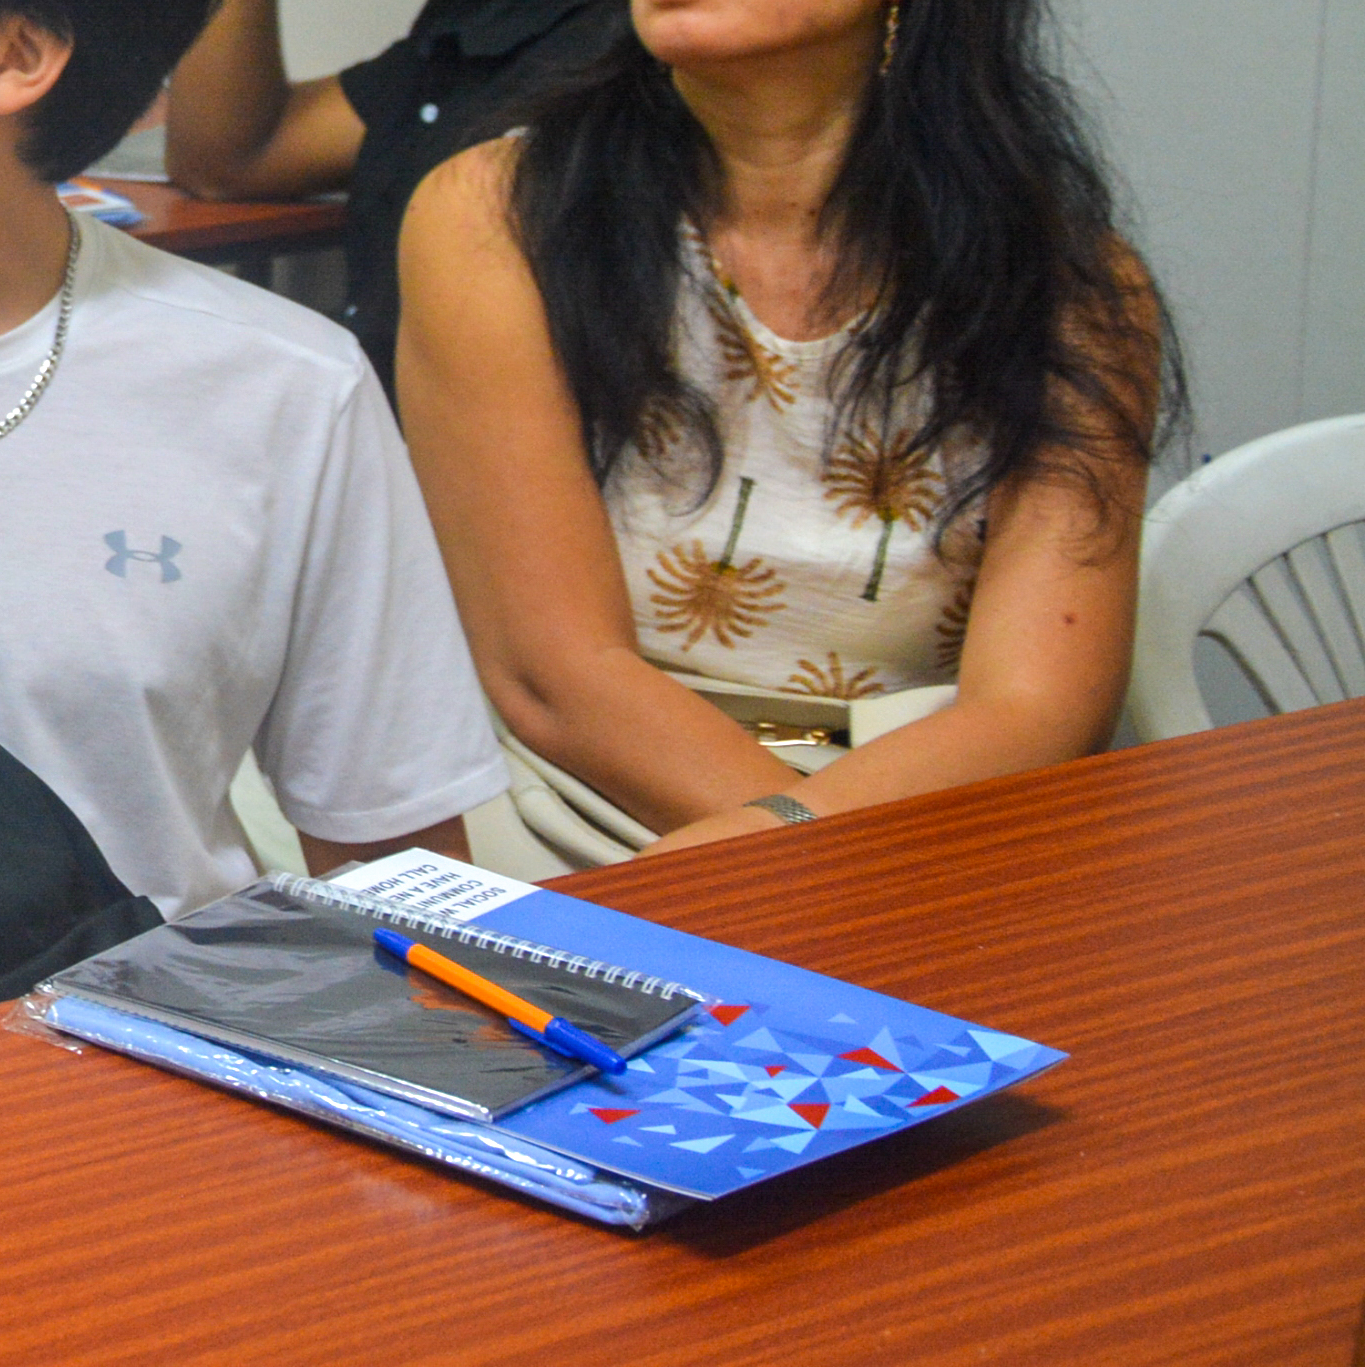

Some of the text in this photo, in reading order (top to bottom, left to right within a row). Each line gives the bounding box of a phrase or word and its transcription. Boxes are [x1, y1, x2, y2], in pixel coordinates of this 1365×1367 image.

[360, 864, 438, 897] CALL HOME
[407, 885, 425, 894] A
[420, 871, 462, 890] HAVE
[452, 886, 507, 909] SOCIAL
